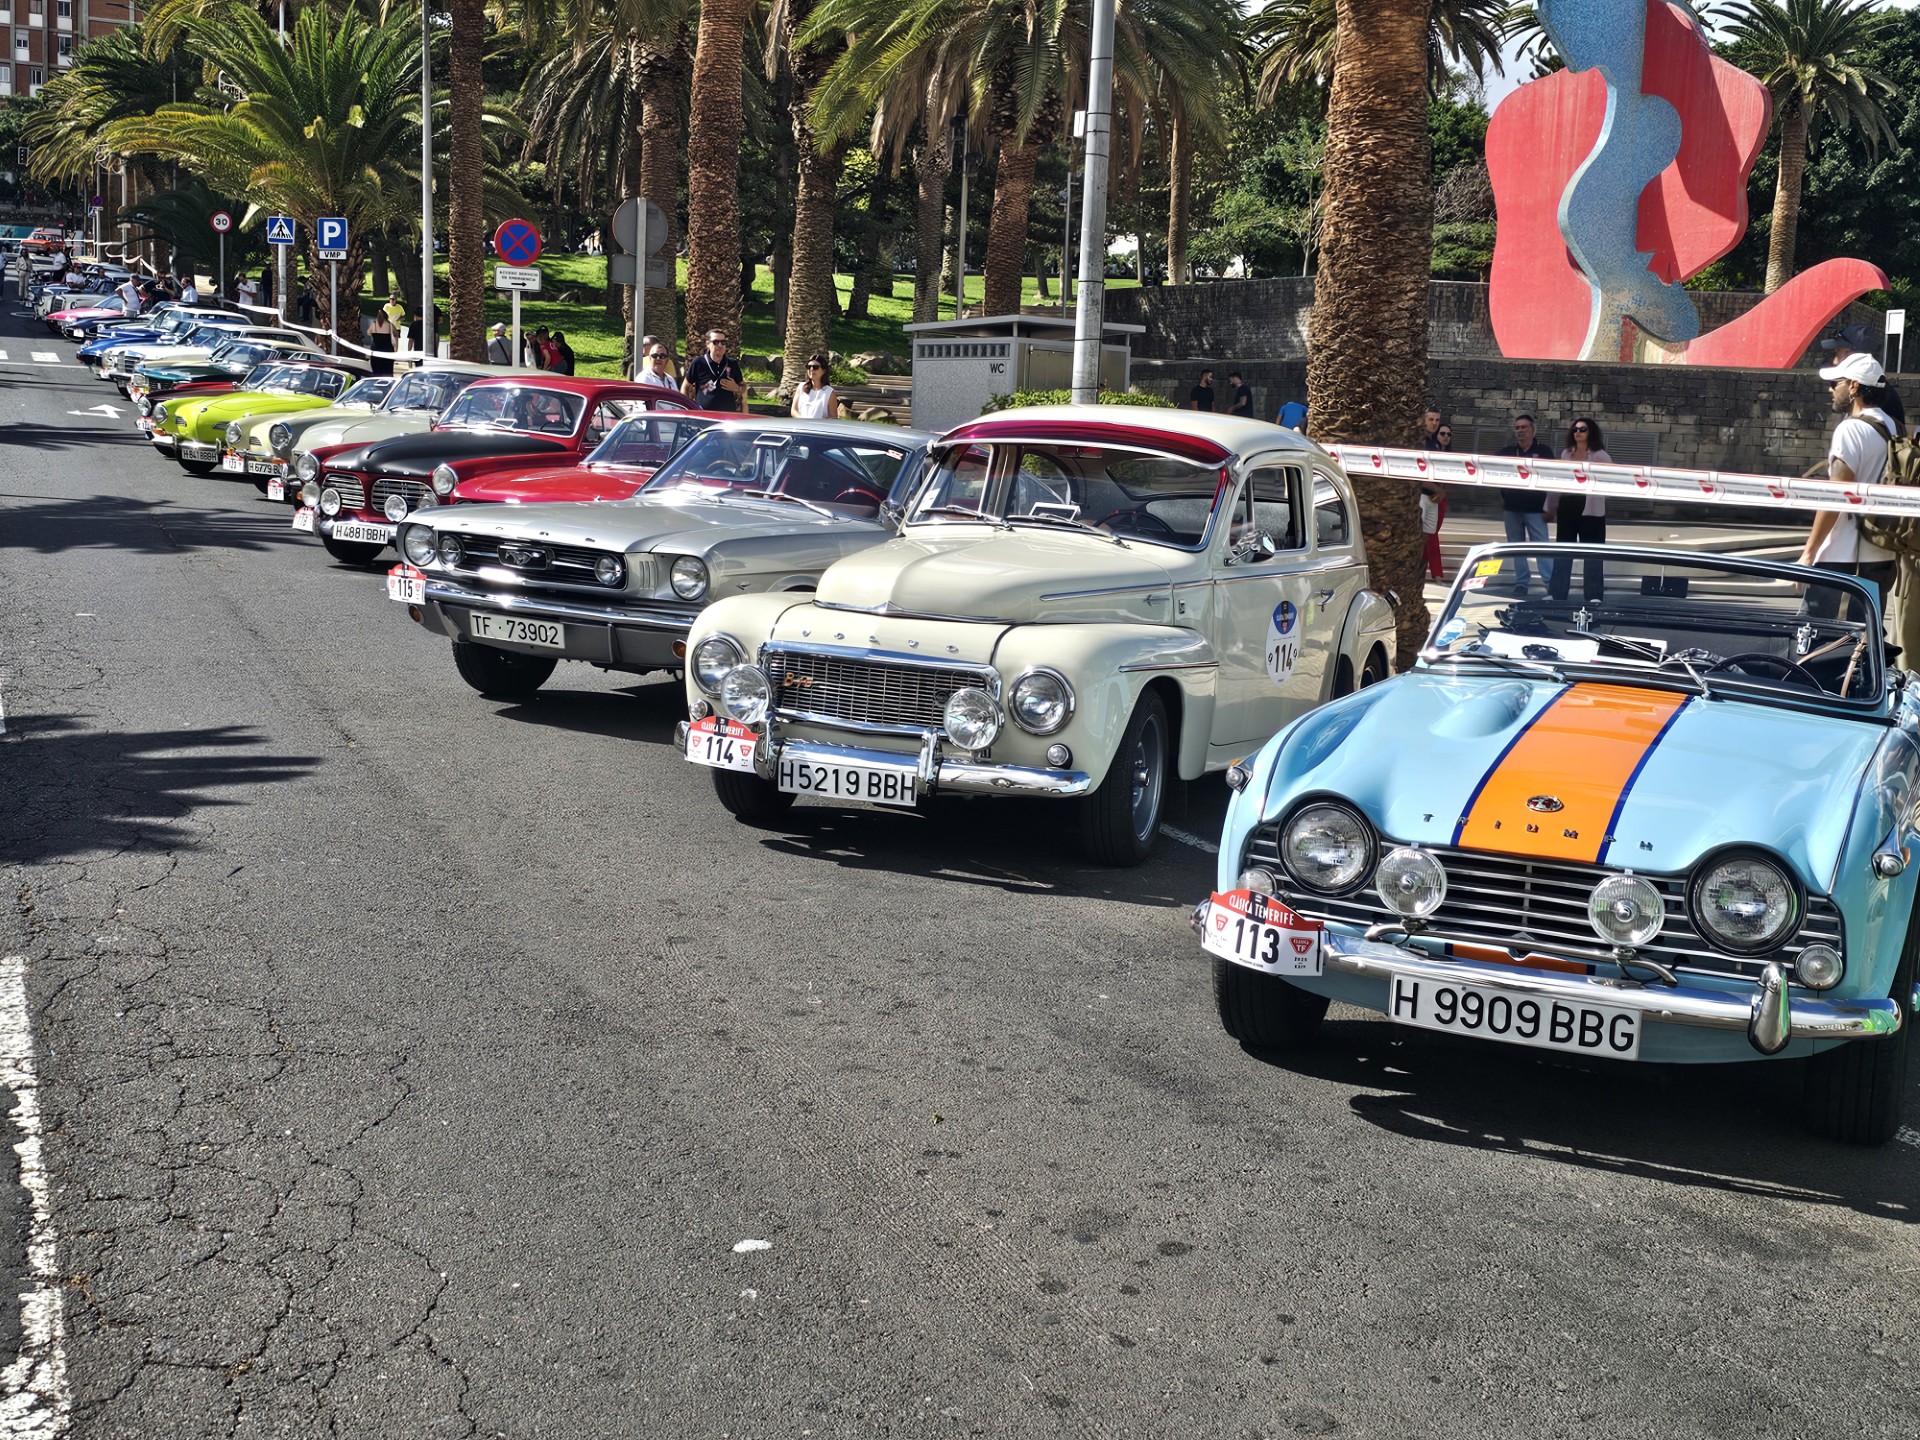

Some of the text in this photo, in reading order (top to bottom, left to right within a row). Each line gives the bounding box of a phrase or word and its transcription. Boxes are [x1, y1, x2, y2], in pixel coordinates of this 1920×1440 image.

[323, 221, 341, 246] P
[990, 363, 1005, 374] WC
[398, 579, 413, 598] 115
[472, 615, 492, 635] TF
[506, 619, 559, 645] 73902
[1275, 643, 1292, 673] 114
[720, 724, 744, 737] TENERIFE
[706, 736, 734, 764] 114
[1423, 813, 1654, 851] TRIUMPH
[1229, 895, 1295, 926] CLÁSICA TENERIFE
[1235, 918, 1280, 965] 113
